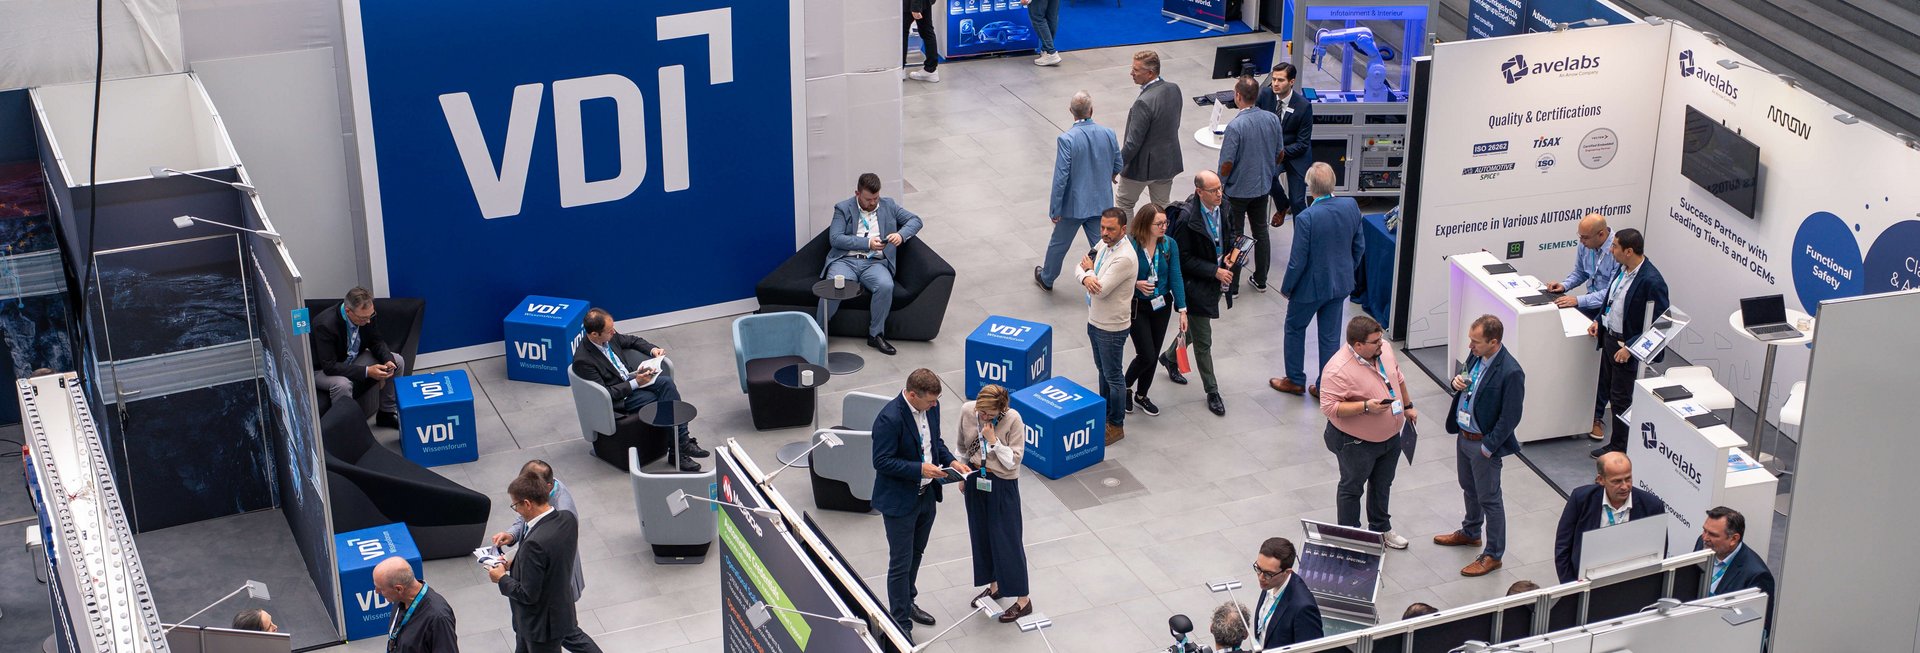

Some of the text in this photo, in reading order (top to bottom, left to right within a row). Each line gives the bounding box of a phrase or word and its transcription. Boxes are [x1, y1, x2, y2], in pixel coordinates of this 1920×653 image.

[1532, 55, 1600, 75] avelabs
[1697, 67, 1738, 100] avelabs
[1488, 104, 1602, 129] Quality & Certifications
[438, 63, 691, 220] VDI
[1474, 143, 1508, 153] ISO 26262
[1474, 163, 1514, 174] AUTOMOTIVE
[1537, 159, 1554, 167] ISO
[1435, 220, 1488, 238] Experience
[1490, 217, 1499, 230] in
[1502, 213, 1538, 229] Various
[1540, 208, 1582, 224] AUTOSAR
[1680, 197, 1768, 262] Success Partner with
[1538, 239, 1578, 251] SIEMENS
[1669, 206, 1702, 238] Leading
[1731, 250, 1747, 266] and
[1750, 261, 1775, 285] OEMs
[1806, 244, 1852, 281] Functional
[1812, 265, 1840, 290] Safety
[527, 303, 561, 315] VDI
[990, 323, 1024, 337] VDI
[514, 341, 547, 361] VDI
[520, 361, 558, 372] Wissensforum
[976, 360, 1007, 383] VDI
[1031, 354, 1045, 380] VDI
[1040, 385, 1074, 403] VDI
[416, 422, 454, 444] VDI
[1025, 424, 1039, 449] DI
[1062, 427, 1090, 453] VDI
[422, 443, 467, 453] Wissensforum
[1658, 442, 1702, 485] avelabs
[356, 538, 385, 561] VDI
[355, 590, 392, 612] VD
[362, 611, 391, 622] Wissens
